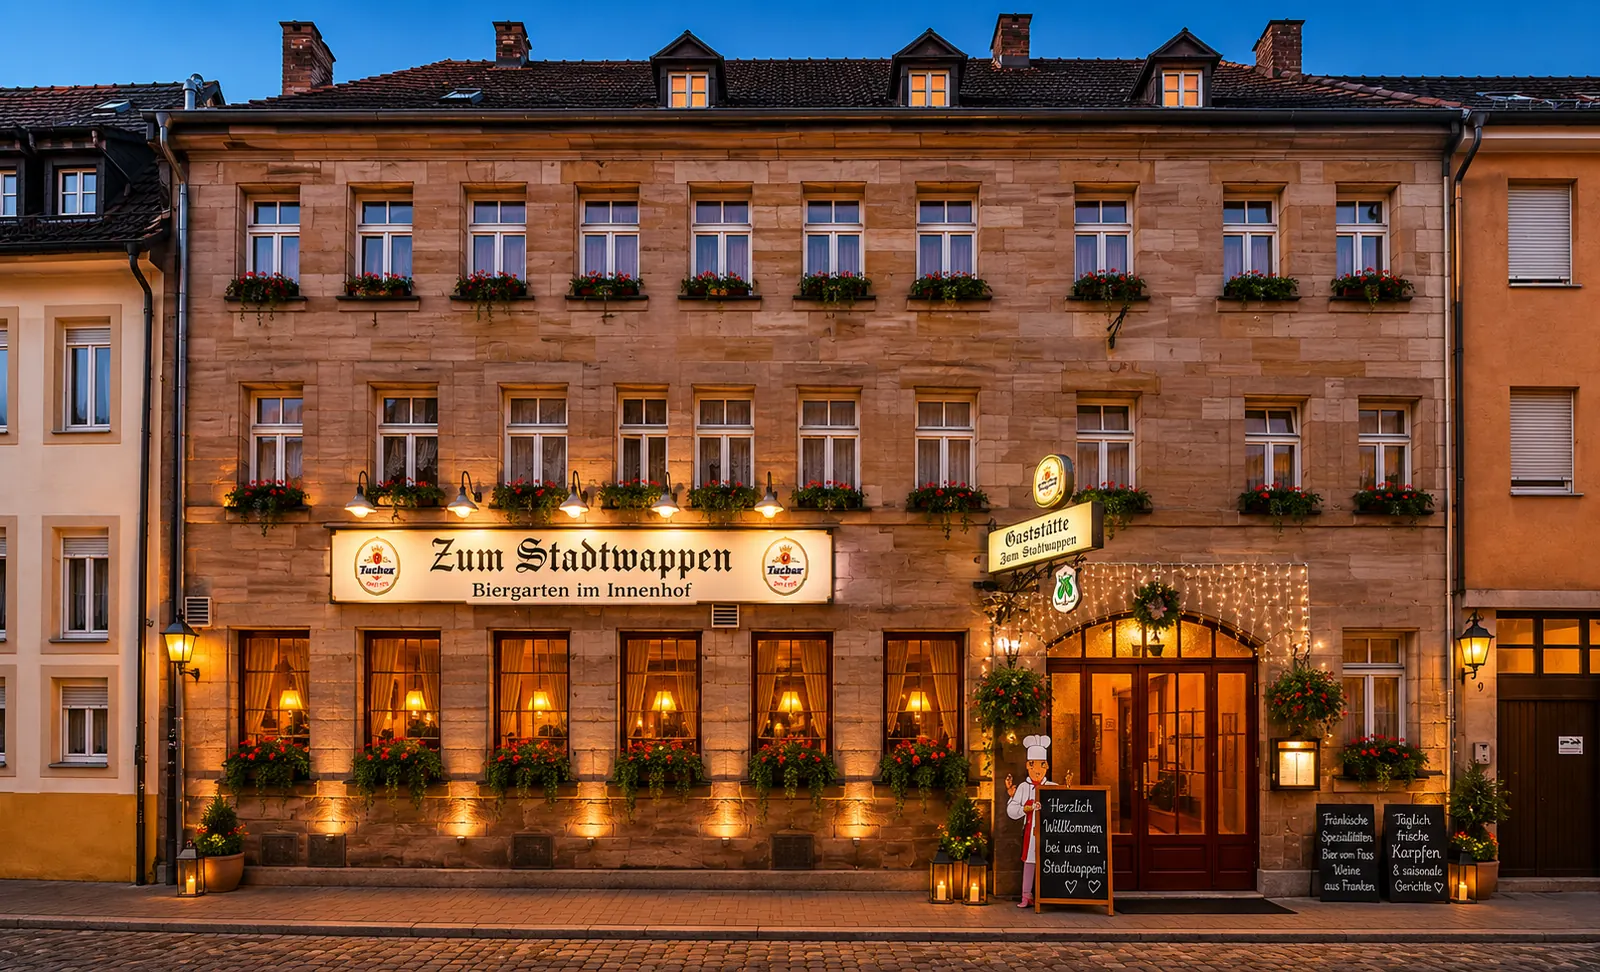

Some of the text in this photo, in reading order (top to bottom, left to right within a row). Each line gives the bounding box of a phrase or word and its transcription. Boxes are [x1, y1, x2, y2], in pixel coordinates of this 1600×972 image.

[430, 537, 732, 580] Zum Stadtwappen
[472, 583, 692, 601] Biergarten im Innenhof
[1047, 798, 1094, 813] Herzlich
[1396, 829, 1430, 842] frische
[1045, 839, 1101, 854] bei uns im
[1322, 848, 1375, 860] Bier vom Fass
[1391, 844, 1442, 864] Karpfen
[1332, 863, 1361, 876] Weine
[1392, 864, 1443, 876] & saisonale
[1324, 879, 1376, 892] aus Franken
[1394, 879, 1432, 892] Gerichte
